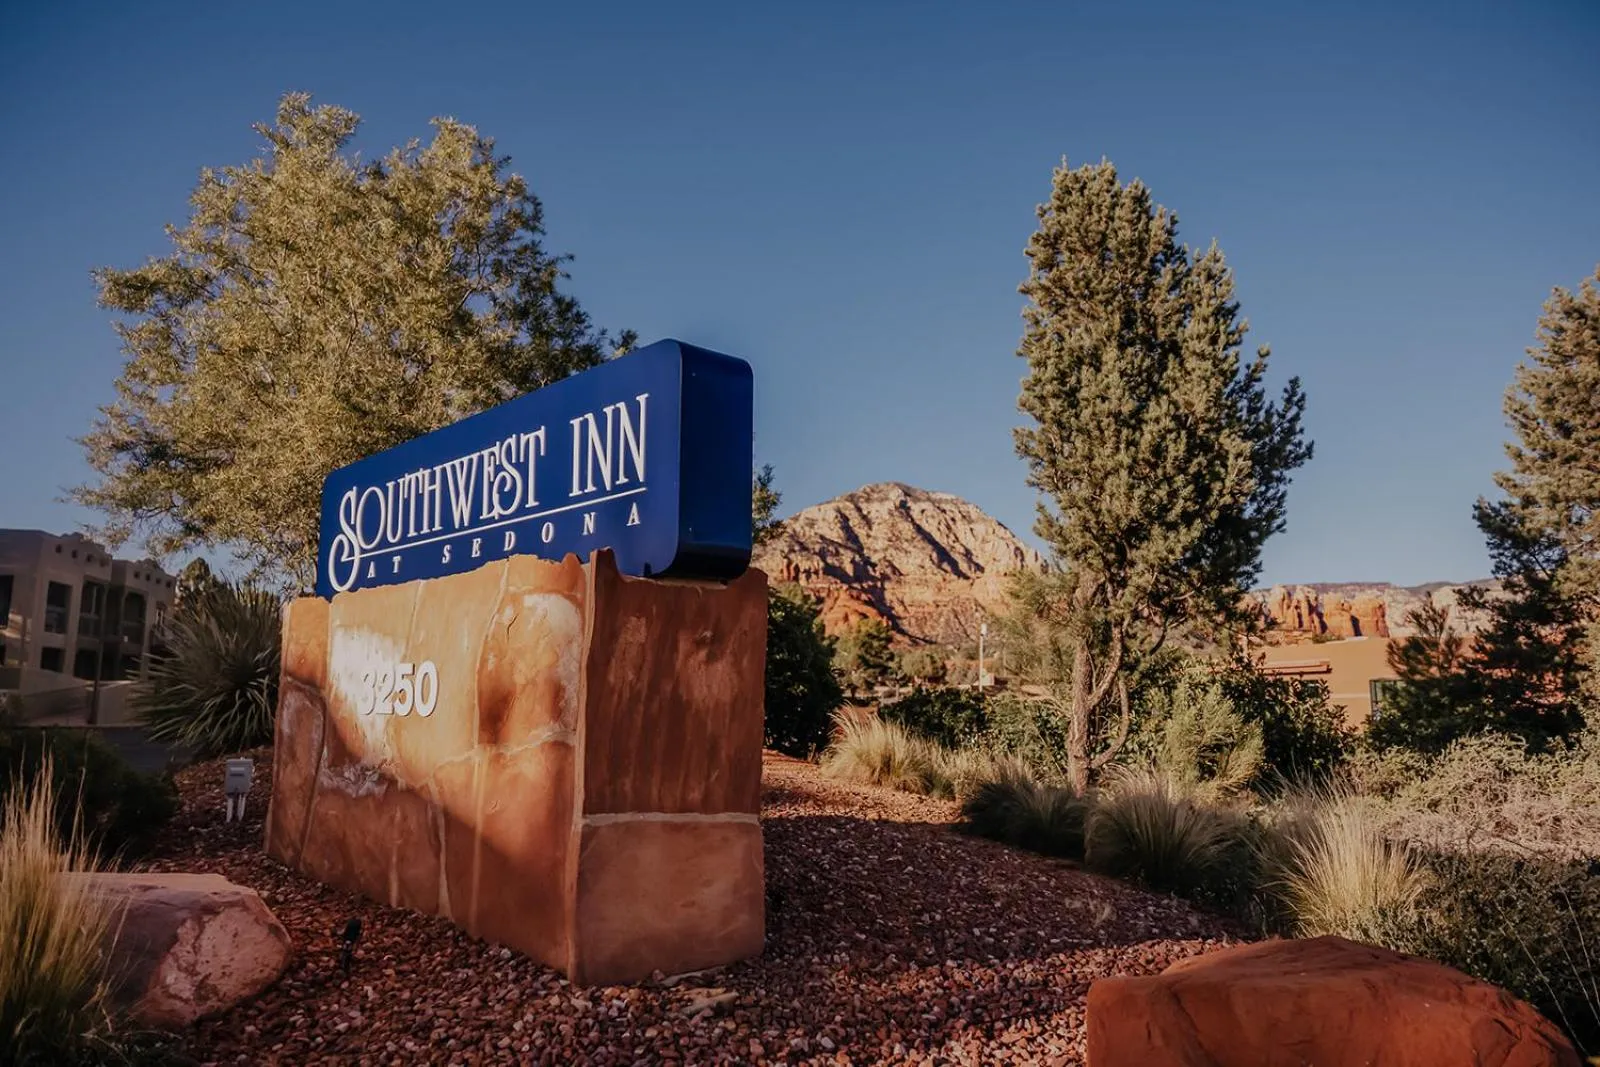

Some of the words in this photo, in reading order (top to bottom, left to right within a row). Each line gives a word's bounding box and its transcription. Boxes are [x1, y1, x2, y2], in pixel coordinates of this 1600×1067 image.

[328, 425, 547, 592] SOUTHWEST
[569, 393, 649, 497] INN
[367, 556, 402, 578] AT
[442, 502, 640, 564] SEDONA
